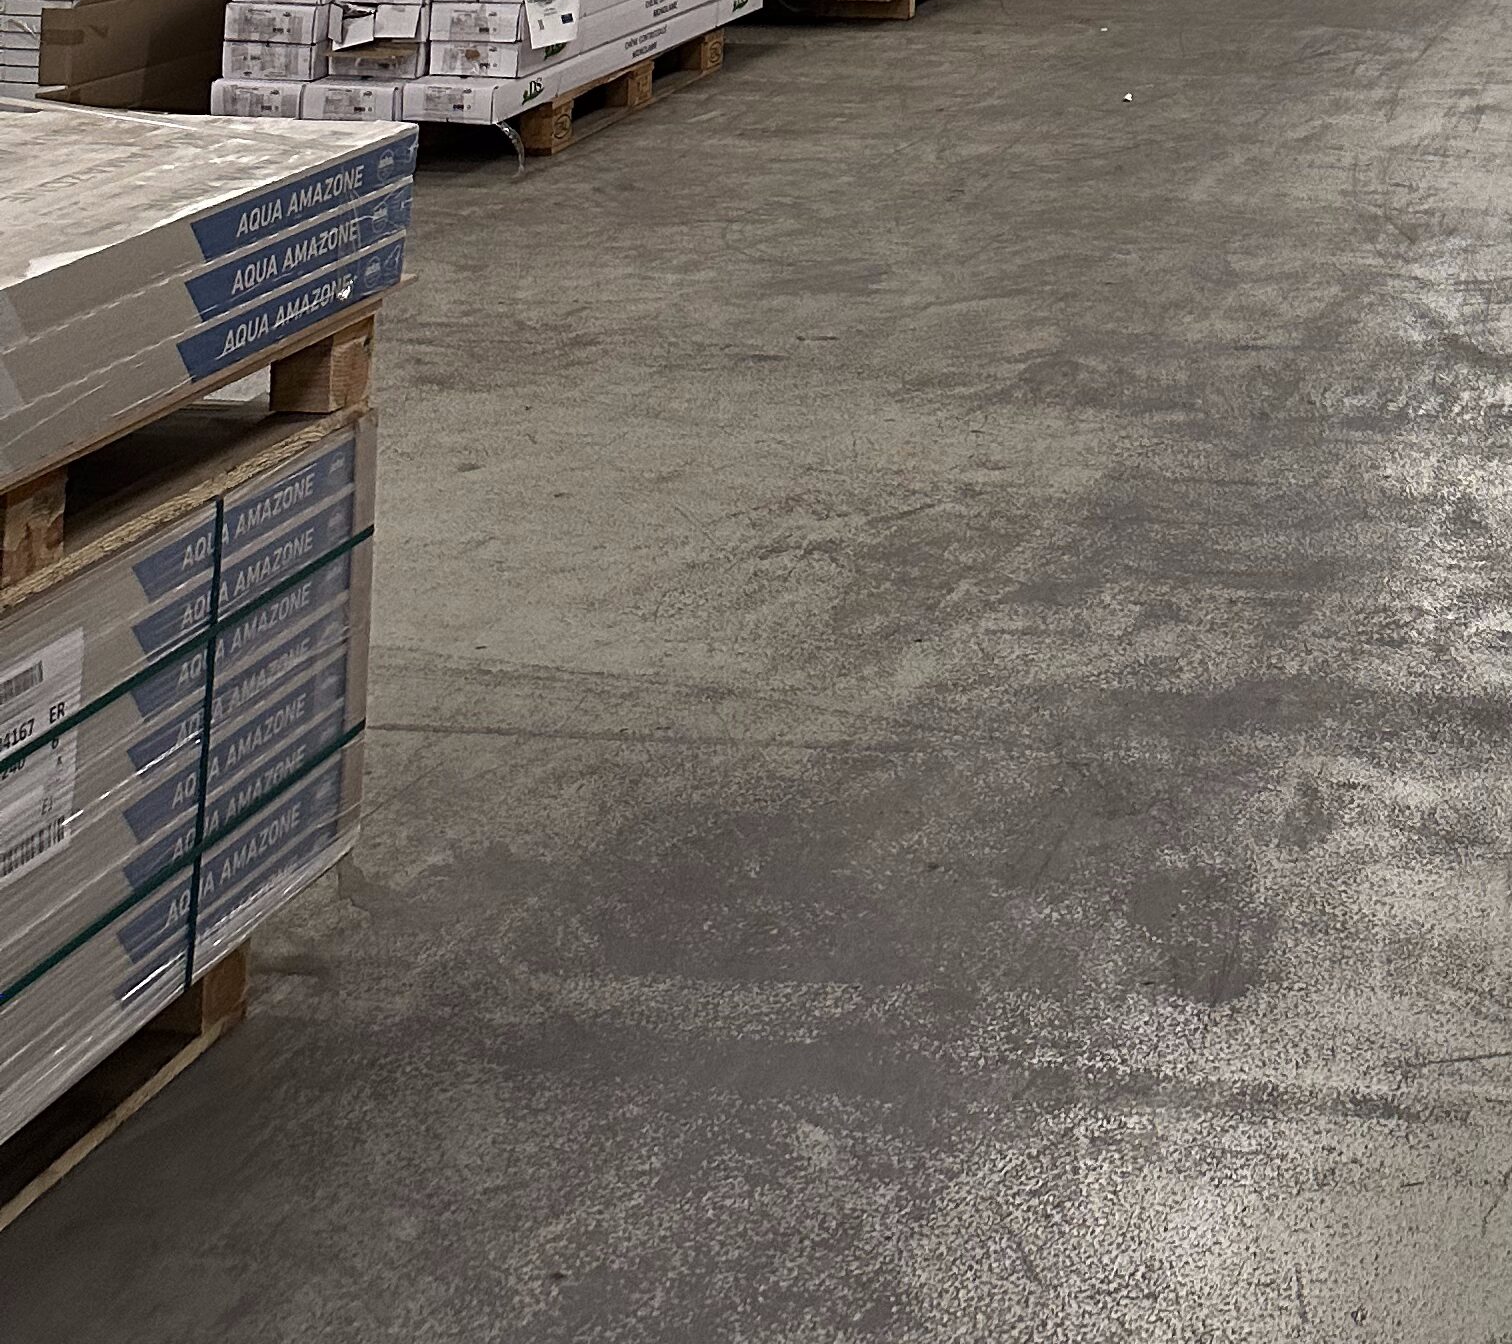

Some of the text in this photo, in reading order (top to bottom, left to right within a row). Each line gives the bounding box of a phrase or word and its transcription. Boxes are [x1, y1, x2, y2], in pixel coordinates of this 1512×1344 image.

[236, 164, 365, 237] AQUA AMAZONE
[232, 219, 359, 294] AQUA AMAZONE
[222, 275, 354, 357] AQUA AMAZONE
[235, 473, 315, 539] AMAZONE
[181, 527, 315, 629] AQA AMAZONE
[178, 582, 312, 687] AQA AMAZONE
[50, 701, 65, 724] ER
[171, 692, 306, 808] AQA AMAZONE
[166, 871, 215, 926] AQA
[220, 801, 302, 885] AMAZONE
[172, 810, 218, 861] AQA
